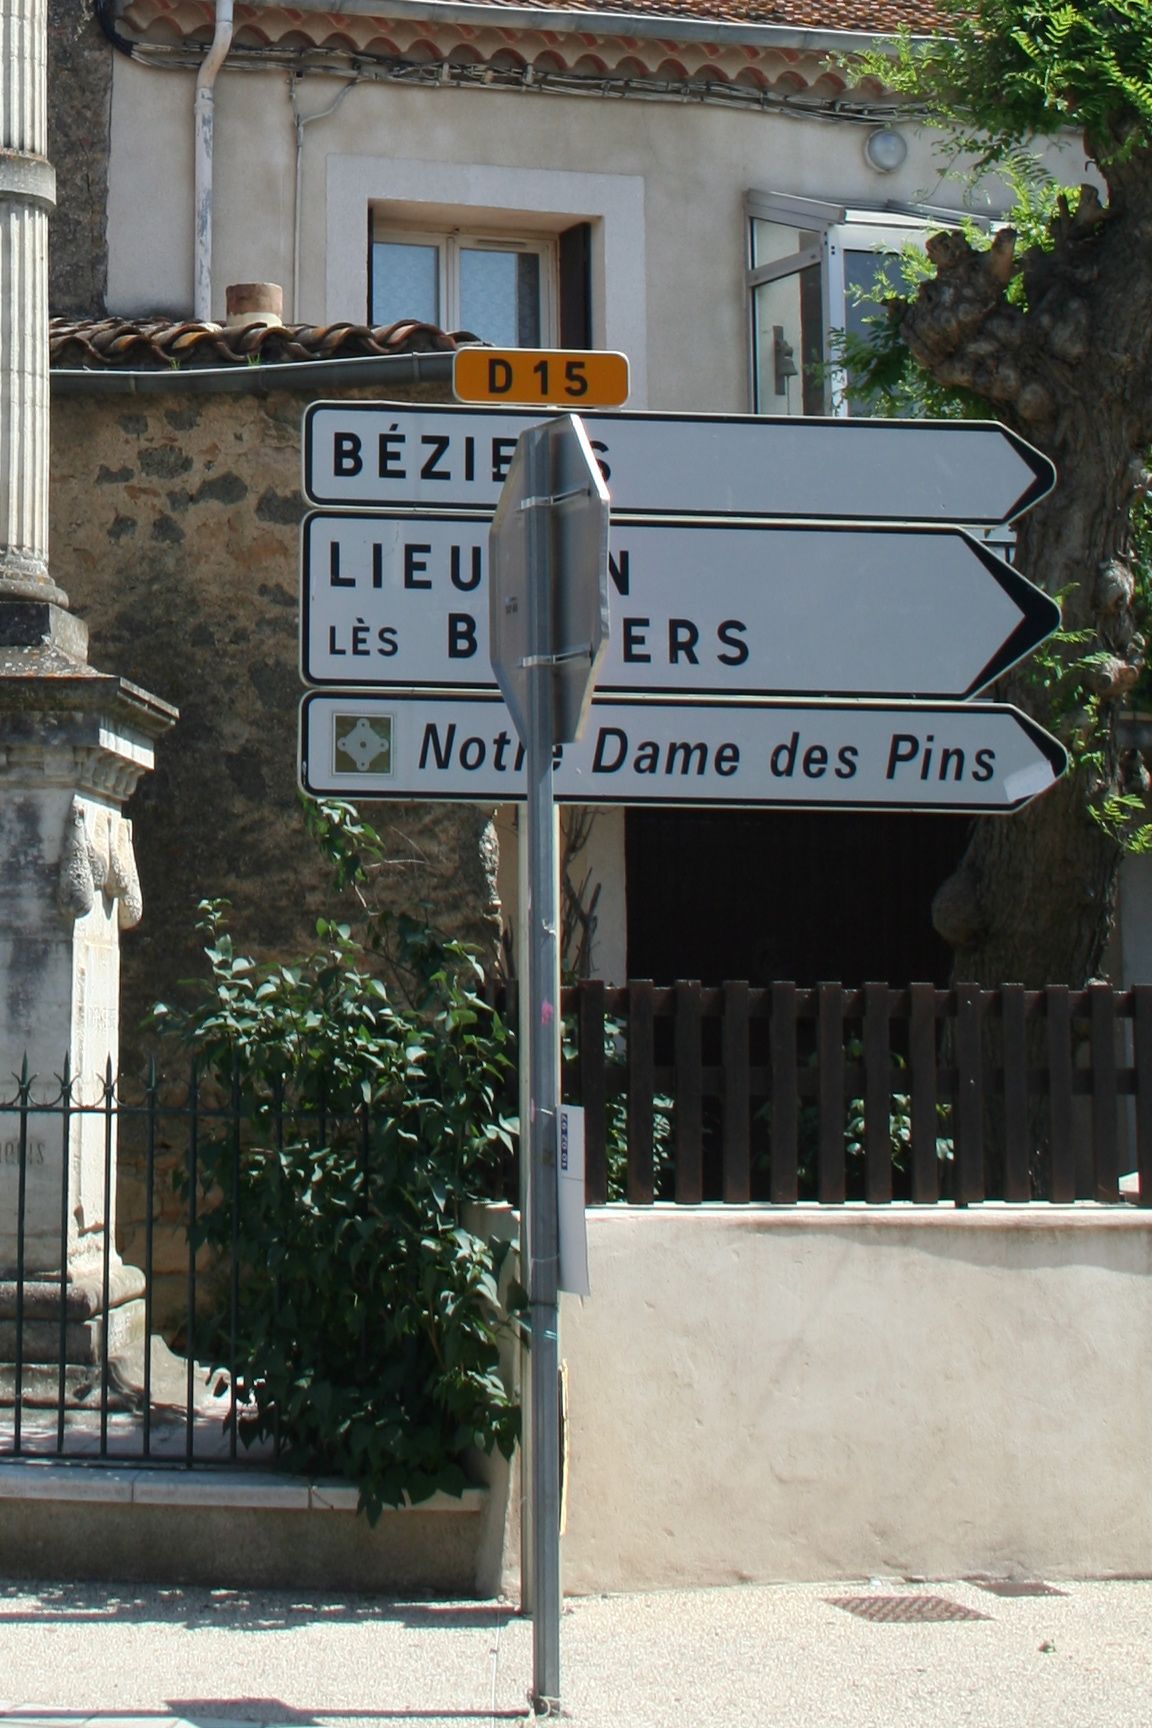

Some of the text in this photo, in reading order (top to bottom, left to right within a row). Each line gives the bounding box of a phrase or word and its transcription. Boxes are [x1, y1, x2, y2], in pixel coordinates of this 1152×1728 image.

[334, 423, 612, 483] BÉZIE
[330, 541, 630, 596] LIEUN
[329, 612, 750, 667] LÈS BERS
[591, 727, 740, 777] Dame
[770, 731, 859, 780] des
[885, 733, 997, 783] Pins
